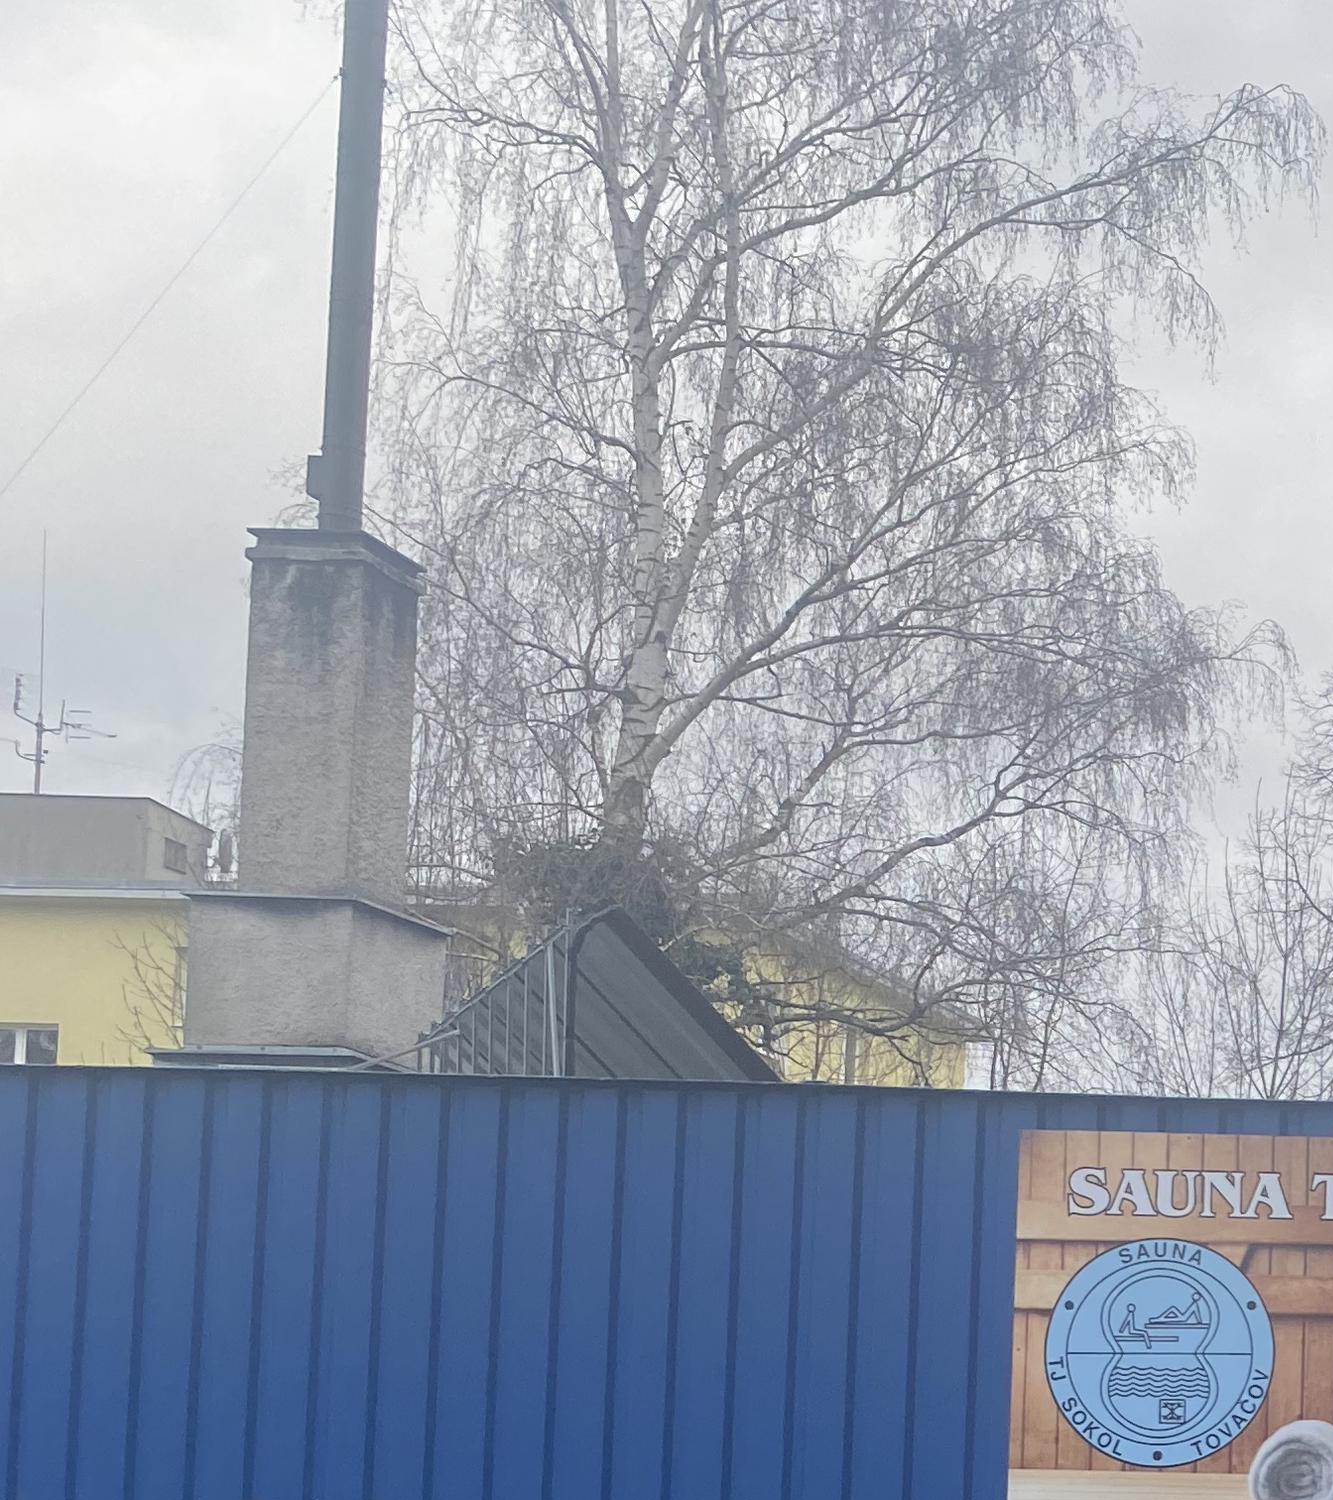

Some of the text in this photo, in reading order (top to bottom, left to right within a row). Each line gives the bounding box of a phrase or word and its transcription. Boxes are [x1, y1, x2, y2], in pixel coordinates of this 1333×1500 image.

[1068, 1166, 1294, 1219] SAUNA
[1118, 1242, 1202, 1266] SAUNA
[1048, 1356, 1269, 1457] TJ SOKOL TOVAČOV
